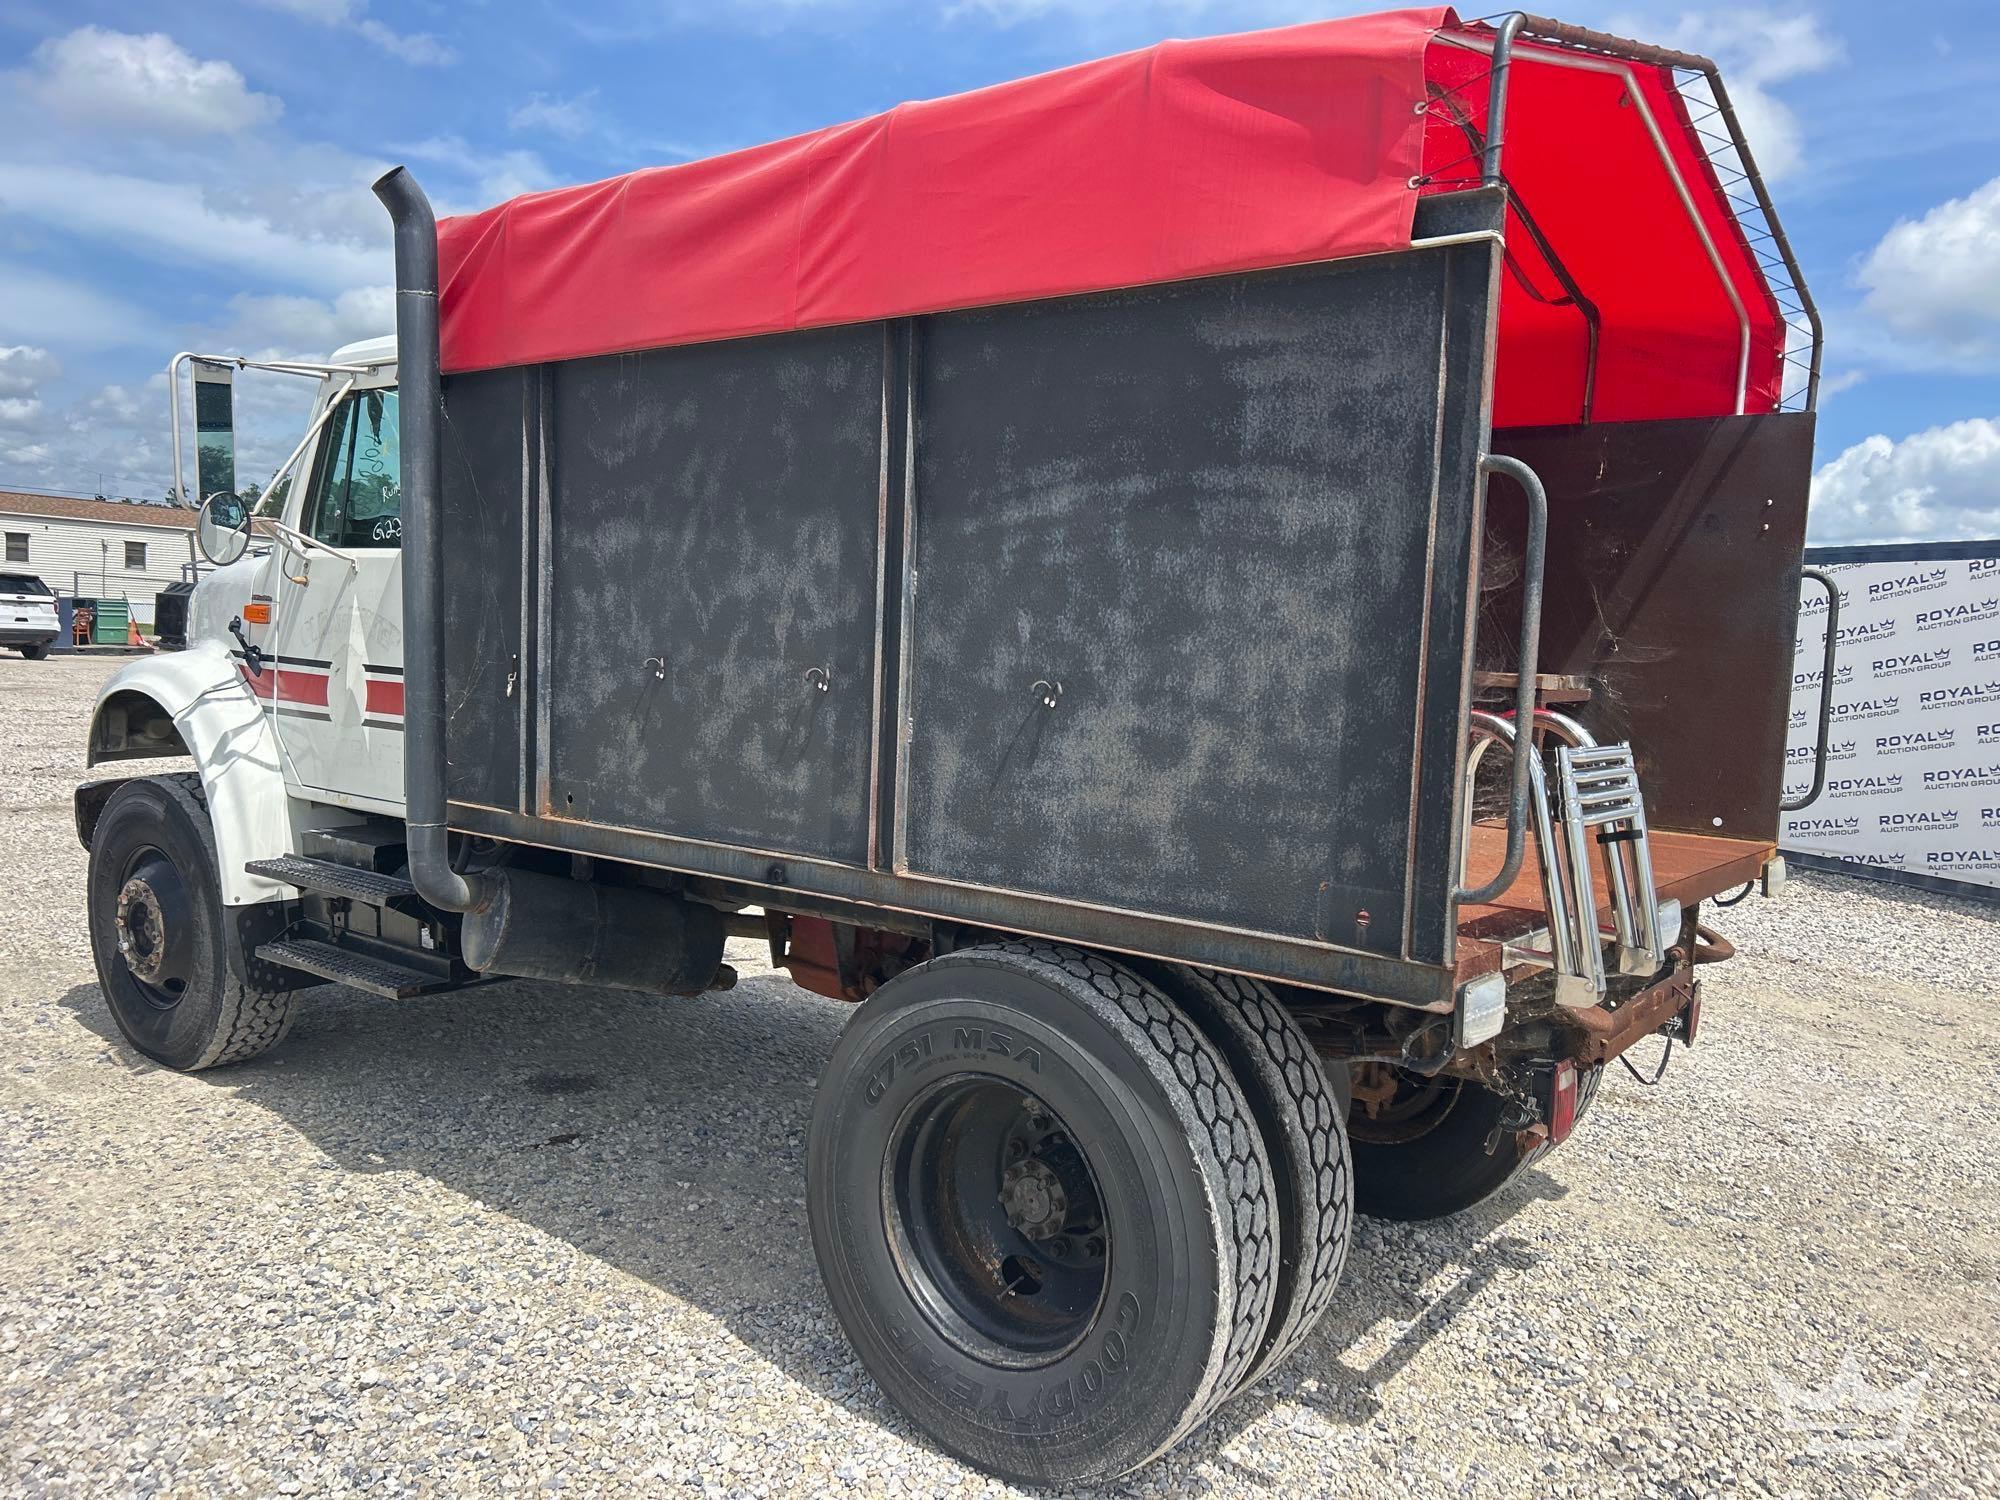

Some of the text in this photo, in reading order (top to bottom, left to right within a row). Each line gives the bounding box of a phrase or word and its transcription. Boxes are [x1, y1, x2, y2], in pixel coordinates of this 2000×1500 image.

[1868, 574, 1930, 595] ROYAL
[1869, 580, 1948, 603] AUCTION GROUP
[1916, 603, 1981, 624] ROYAL
[1917, 611, 2000, 632] AUCTION GROUP
[1863, 630, 1897, 642] GROUP
[1872, 652, 1933, 671] ROYAL
[1873, 660, 1951, 679] AUCTION GROUP
[1919, 685, 1985, 703] ROYAL
[1920, 699, 1965, 711] AUCTION
[1866, 708, 1900, 719] GROUP
[1875, 732, 1938, 748] ROYAL
[1876, 741, 1956, 756] AUCTION GROUP
[1787, 757, 1817, 766] AUCTIO
[1923, 767, 1989, 782] ROYAL
[1828, 777, 1886, 791] ROYAL
[1924, 778, 2000, 791] AUCTION GROU
[1829, 786, 1904, 799] AUCTION GROUP
[1788, 819, 1844, 831] ROYAL
[1879, 812, 1941, 826] ROYAL
[1789, 828, 1860, 838] AUCTION GROUP
[1880, 822, 1959, 833] AUCTION GROUP
[1926, 850, 1993, 863] ROYAL
[1927, 863, 1973, 871] AUCTION
[864, 1027, 1041, 1106] G751 MSA
